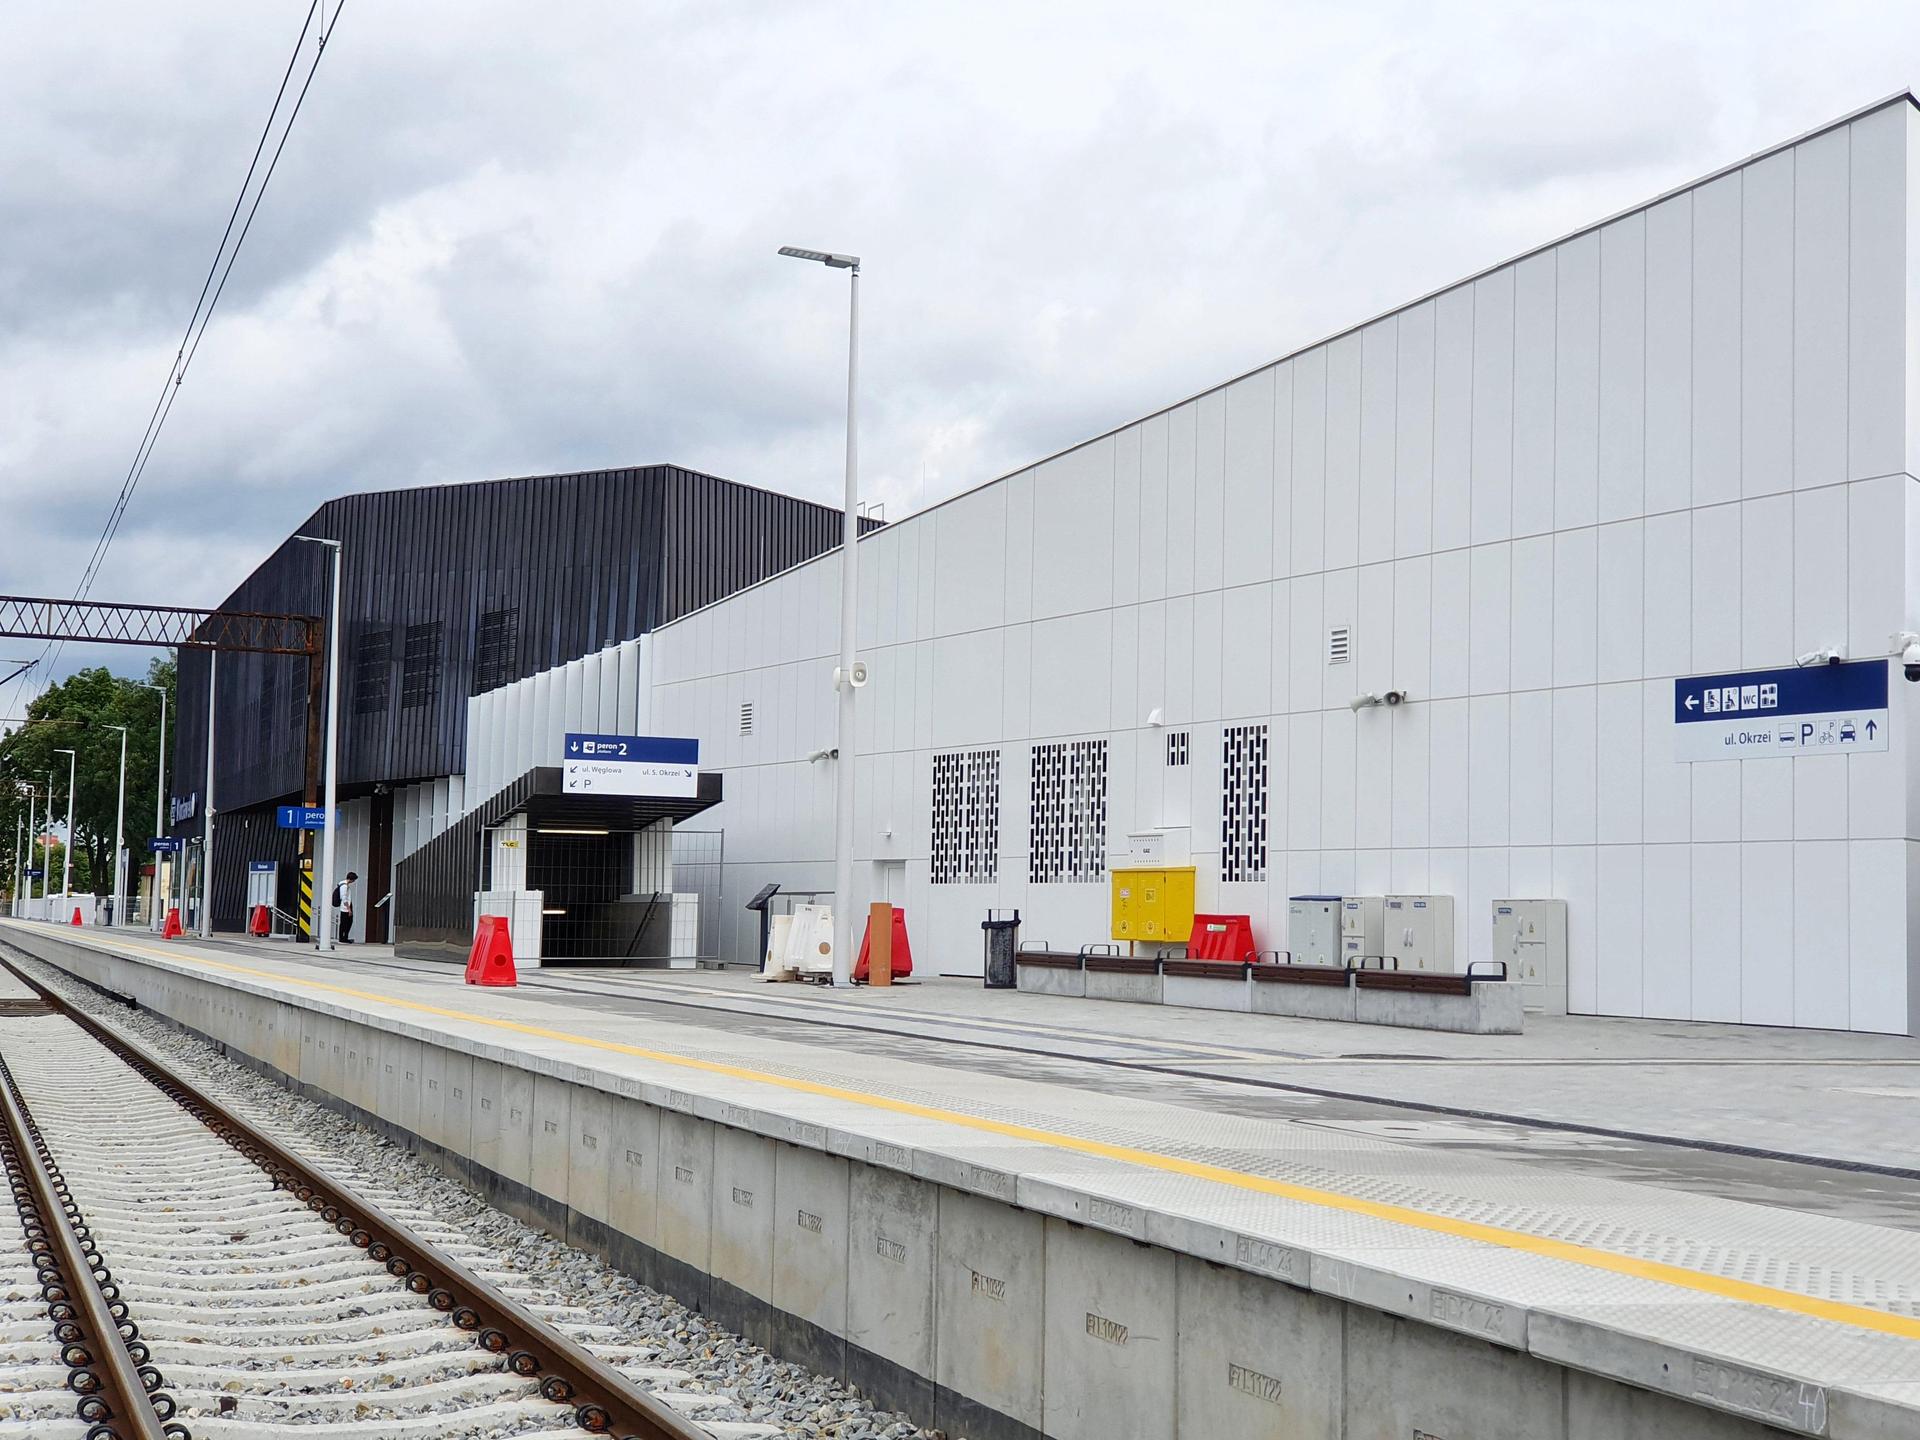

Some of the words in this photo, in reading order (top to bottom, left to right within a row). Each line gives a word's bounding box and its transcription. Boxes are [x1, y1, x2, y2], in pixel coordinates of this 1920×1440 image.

[1743, 695, 1756, 704] WC
[1725, 733, 1736, 745] ul.
[1739, 730, 1771, 744] Okrzei
[618, 743, 627, 756] 2
[659, 769, 681, 777] Okrzei
[584, 779, 591, 788] P
[287, 810, 293, 824] 1
[305, 812, 325, 820] pero
[174, 842, 179, 850] 1
